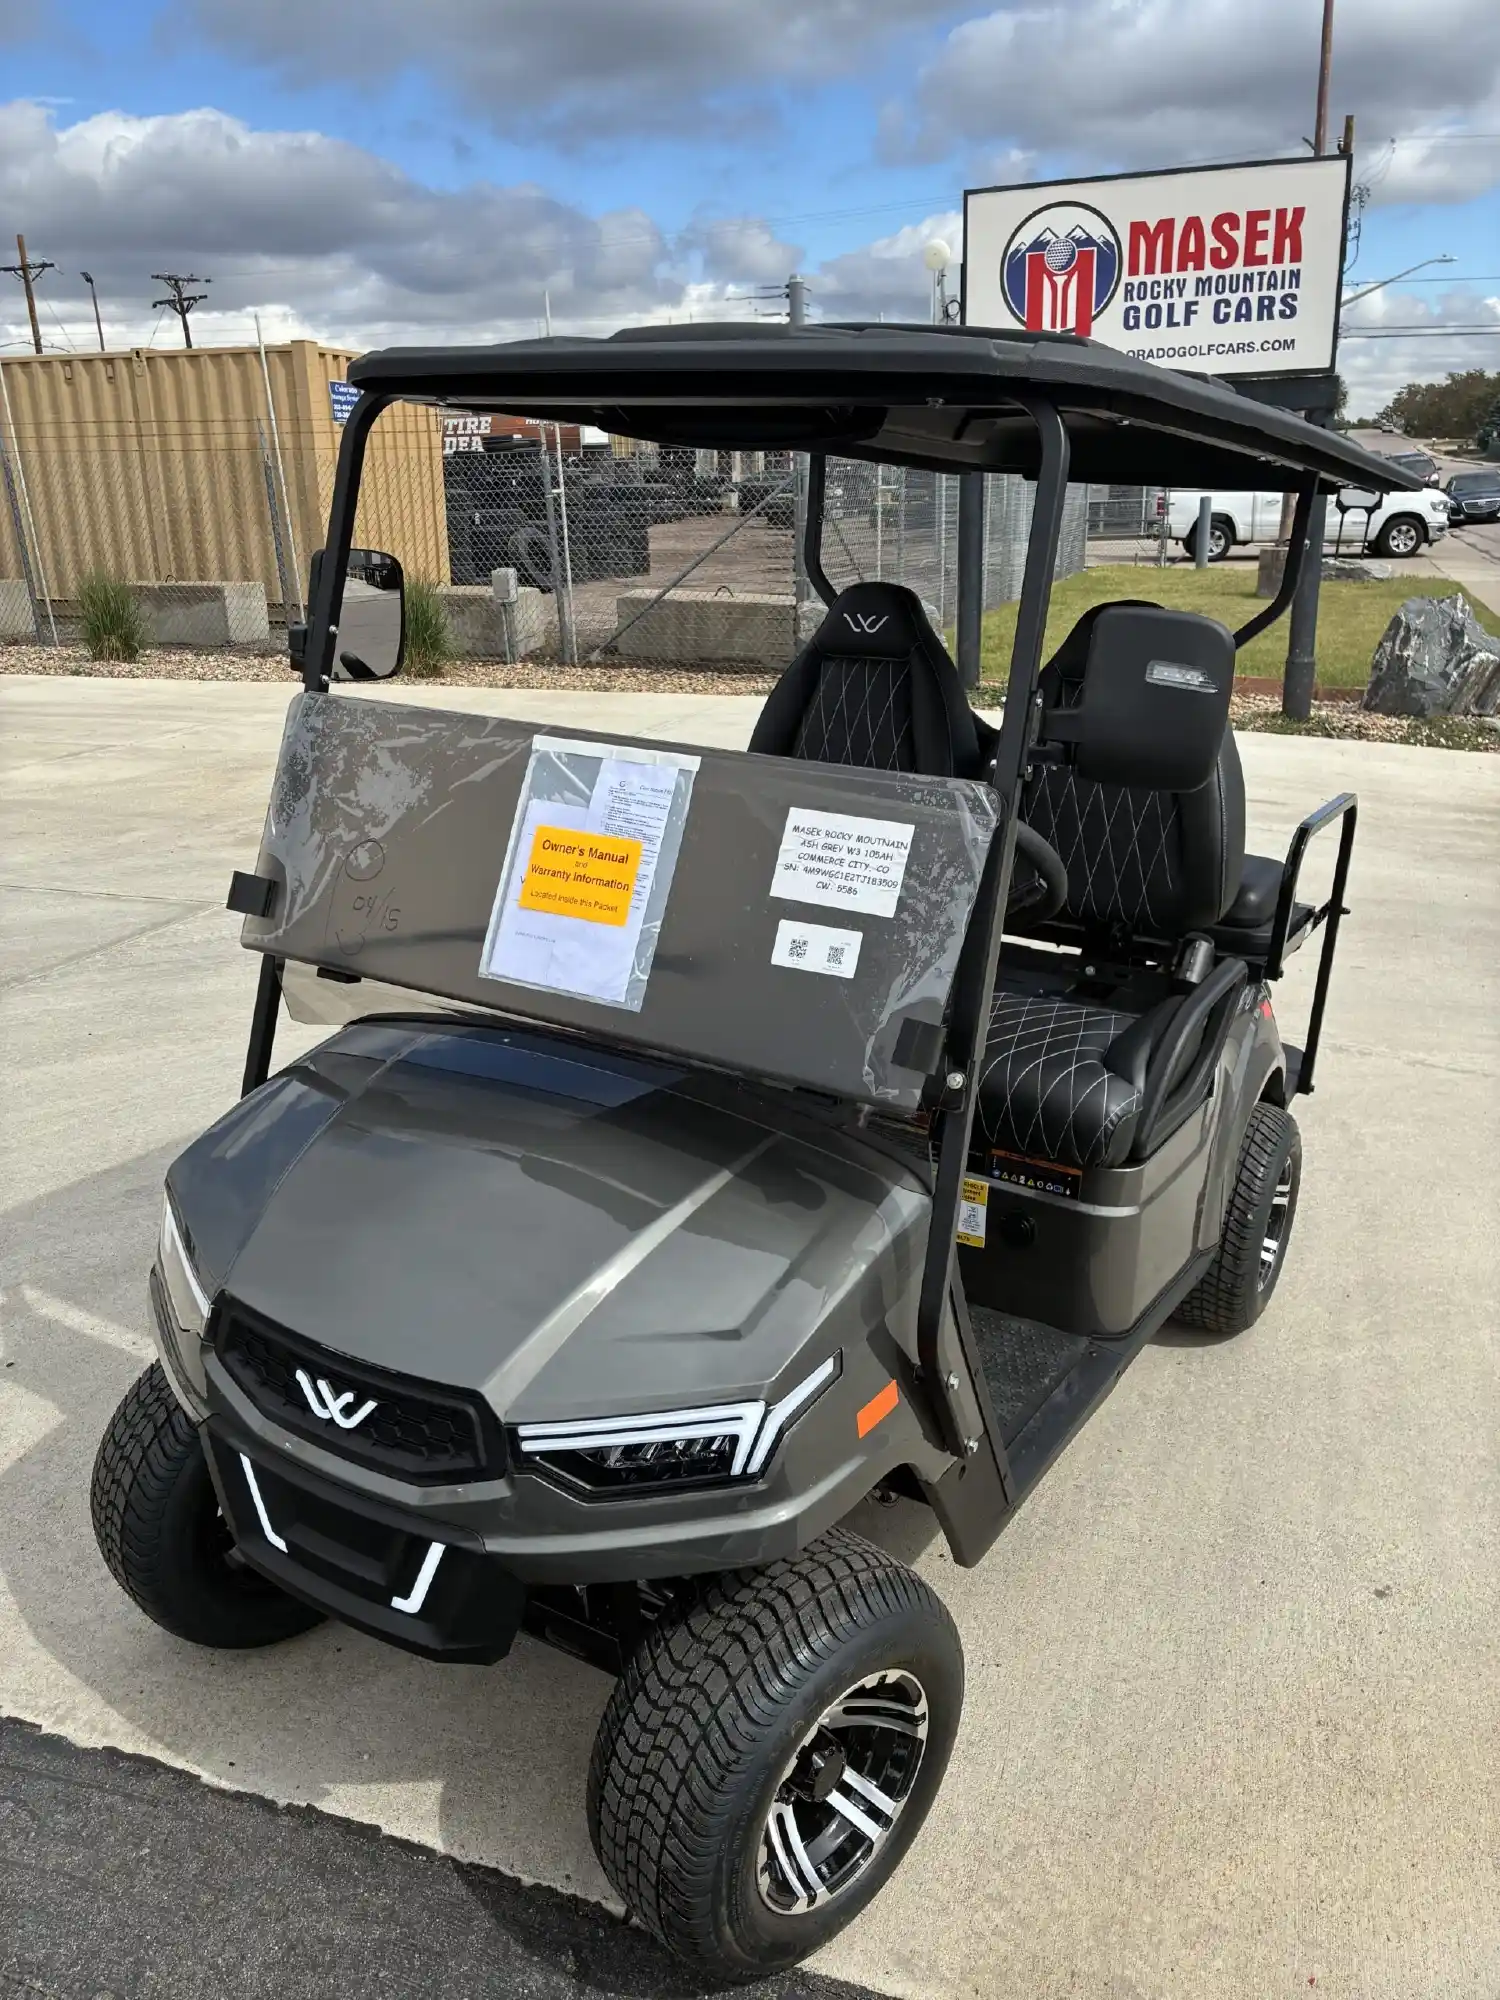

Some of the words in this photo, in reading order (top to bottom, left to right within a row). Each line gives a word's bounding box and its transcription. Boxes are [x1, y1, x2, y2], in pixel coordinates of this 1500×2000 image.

[1127, 206, 1306, 276] MASEK
[1123, 276, 1187, 303] ROCKY
[1195, 268, 1301, 297] MOUNTAIN
[1122, 300, 1199, 331] GOLF
[1213, 292, 1298, 323] CARS
[444, 416, 492, 435] TIRE
[792, 824, 823, 837] MASEK
[825, 830, 854, 841] ROCKY
[855, 834, 909, 850] MOUTNAIN
[542, 839, 585, 857] Owner's
[588, 847, 629, 865] Manual
[797, 852, 846, 868] COMMERCE
[876, 865, 890, 874] CO
[800, 840, 819, 850] ASH
[821, 842, 844, 853] GREY
[847, 846, 861, 856] W3
[864, 849, 894, 861] 105AH
[531, 863, 572, 883] Warranty
[573, 871, 630, 892] Information
[574, 861, 589, 869] and
[783, 862, 800, 872] SN:
[530, 888, 558, 901] Located
[580, 898, 592, 908] this
[593, 900, 619, 913] Packet
[836, 884, 858, 896] 5586
